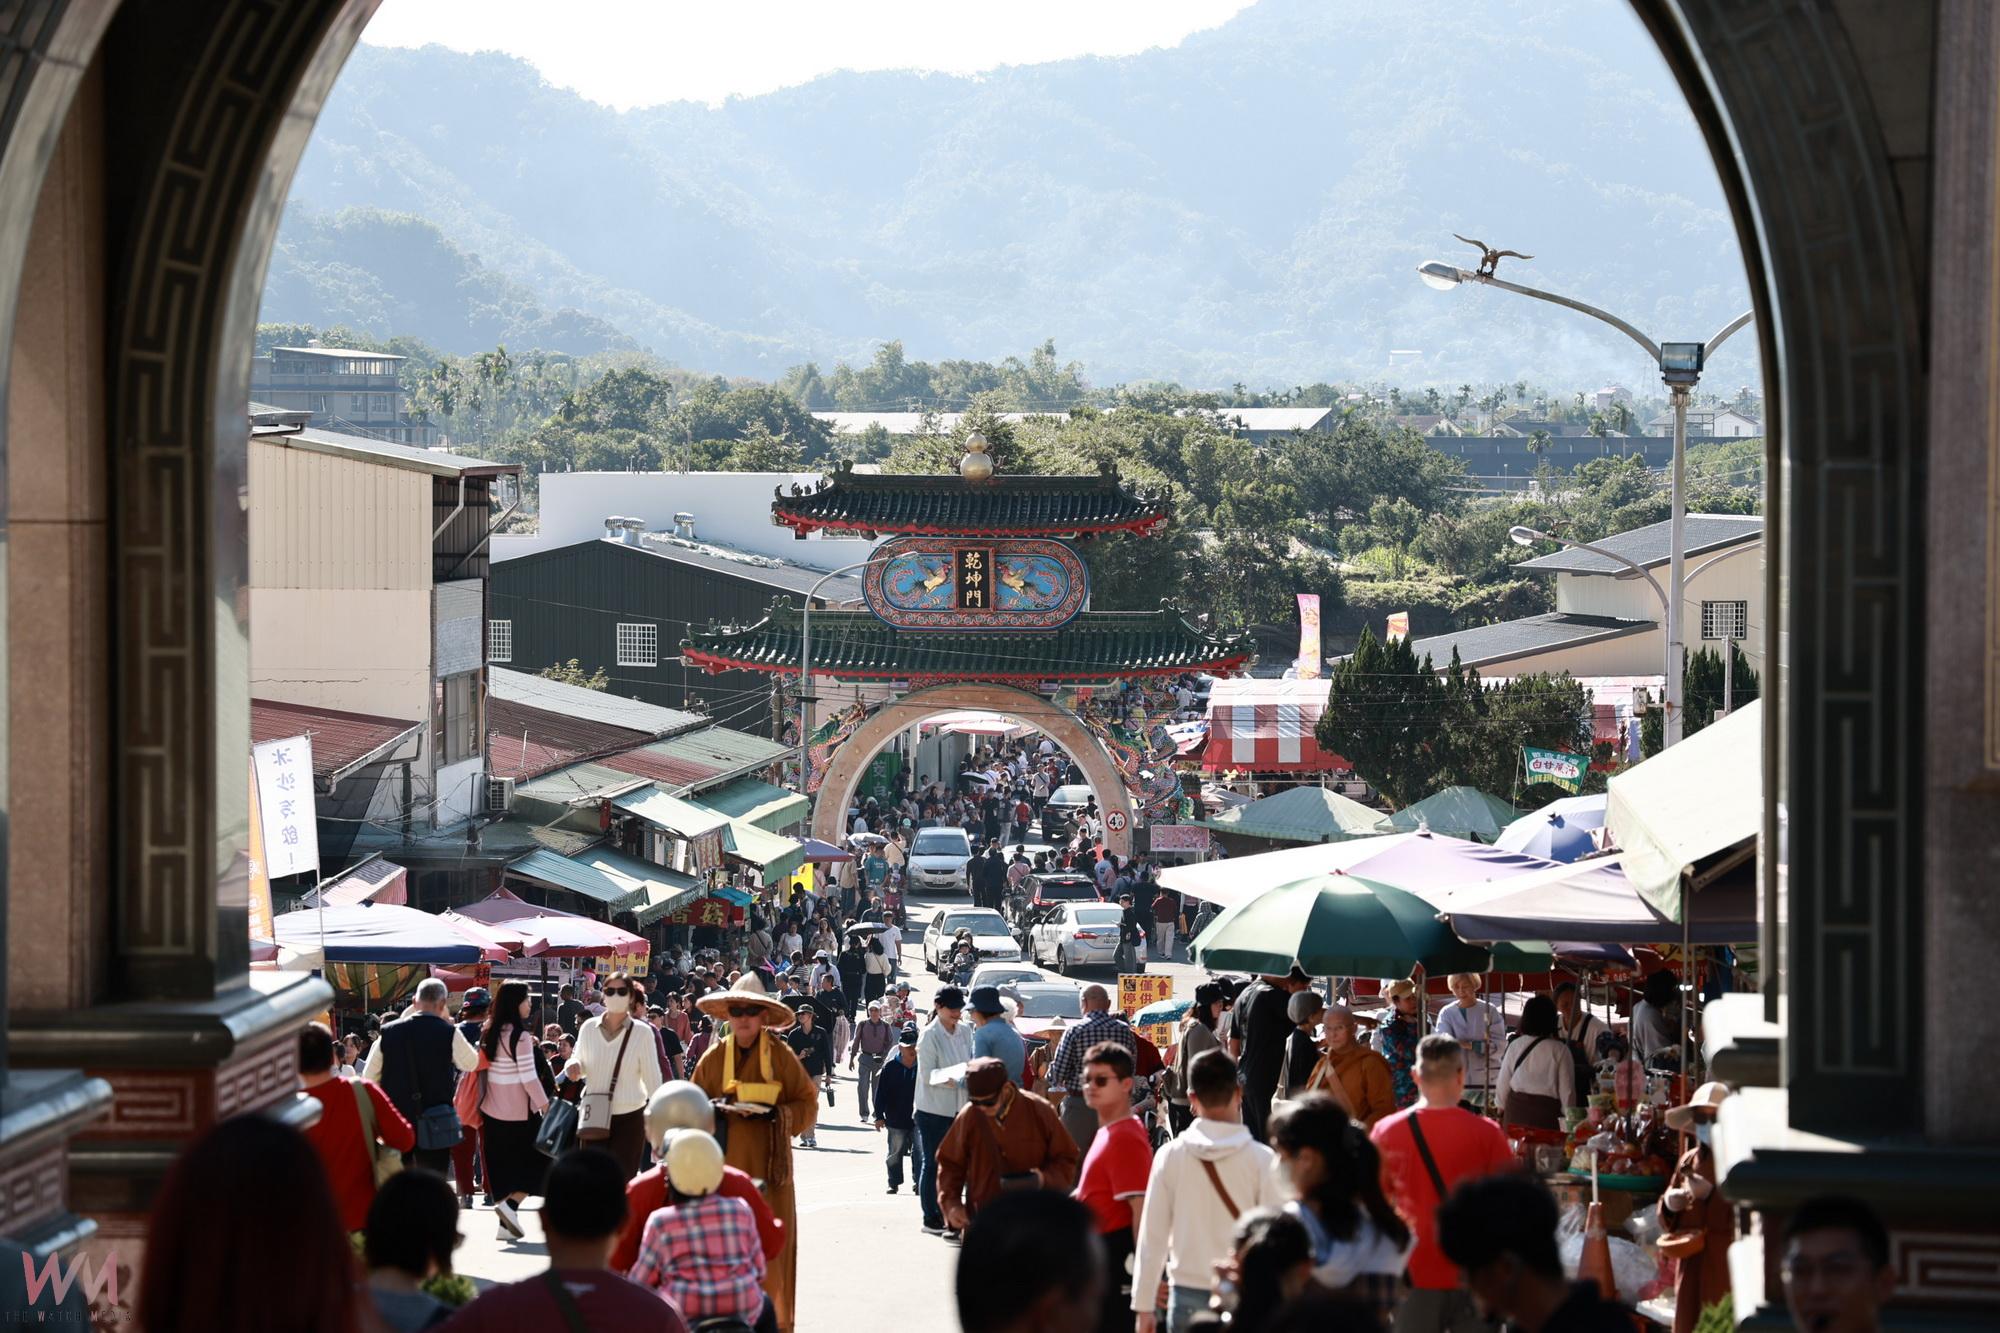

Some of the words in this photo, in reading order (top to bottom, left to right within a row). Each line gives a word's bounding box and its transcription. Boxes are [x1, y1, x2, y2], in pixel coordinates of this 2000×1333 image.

[964, 552, 982, 608] 乾坤門
[1533, 759, 1576, 777] 白甘蔗汁
[672, 902, 723, 926] 香菇
[1140, 980, 1153, 1004] 僅供
[584, 1104, 591, 1121] B
